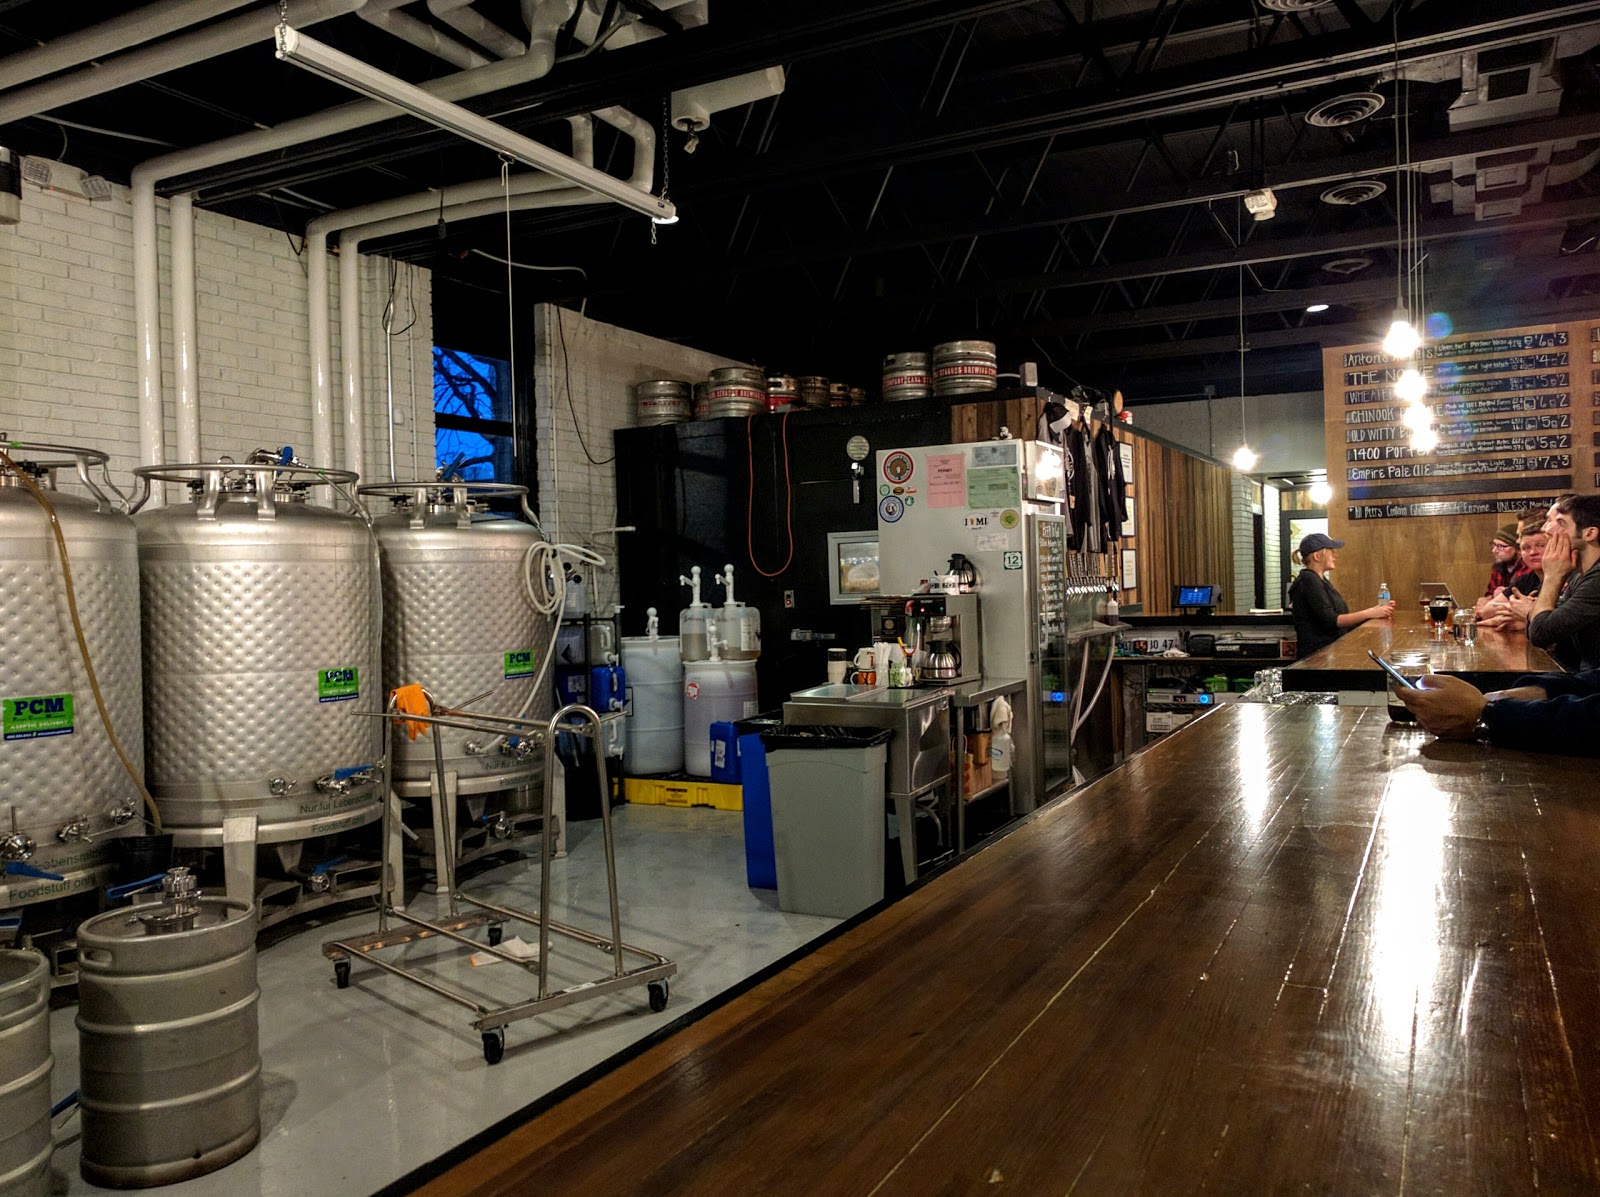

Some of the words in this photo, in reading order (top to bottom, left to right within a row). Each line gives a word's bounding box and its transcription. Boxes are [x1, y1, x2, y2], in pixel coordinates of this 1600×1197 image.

[1353, 447, 1380, 461] 1400
[1496, 501, 1527, 512] UNLESS
[1007, 555, 1019, 565] 12
[509, 652, 531, 664] PCM
[14, 697, 65, 716] PCM
[9, 881, 71, 900] Foodstuff
